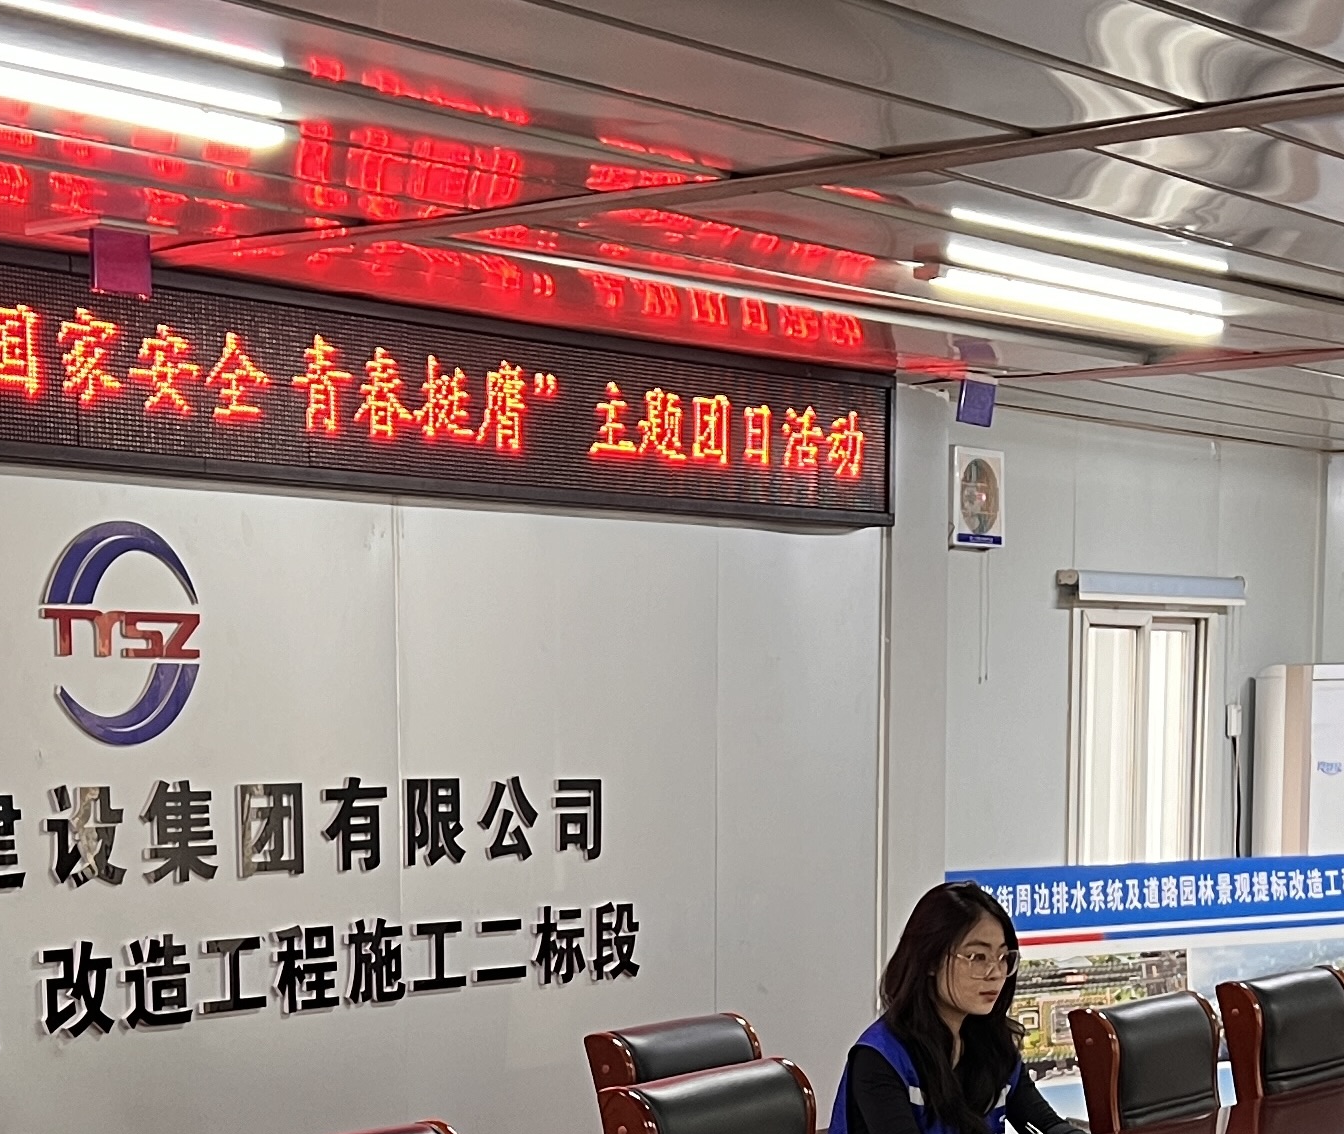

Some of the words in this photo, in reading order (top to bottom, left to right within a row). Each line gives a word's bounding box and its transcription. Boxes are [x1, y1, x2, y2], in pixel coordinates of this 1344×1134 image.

[588, 380, 865, 477] 主题团日活动
[40, 606, 201, 660] TYSZ
[40, 901, 641, 1038] 改造工程施工二标段
